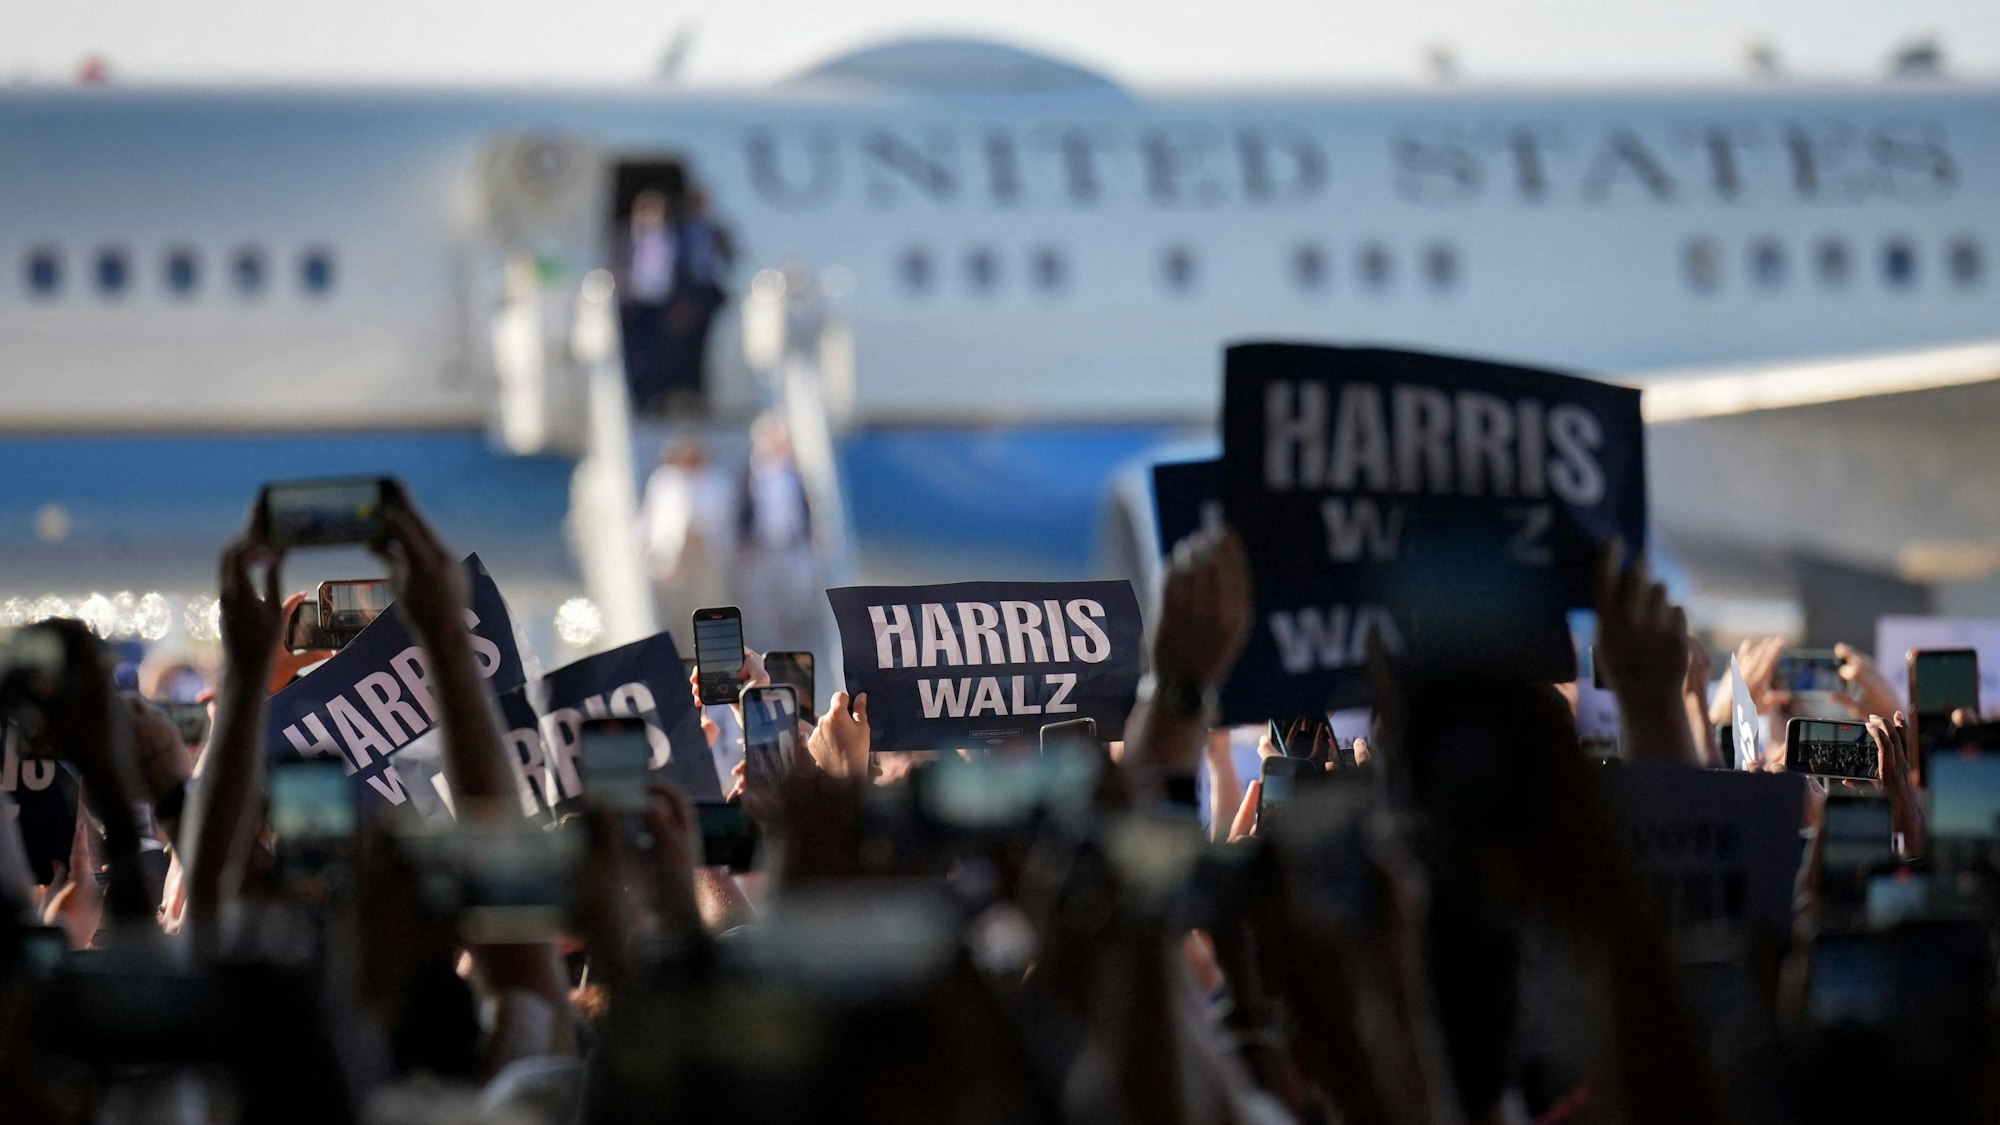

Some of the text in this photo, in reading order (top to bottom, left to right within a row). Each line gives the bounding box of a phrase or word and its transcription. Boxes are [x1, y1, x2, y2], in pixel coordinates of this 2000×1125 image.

[742, 117, 1960, 208] UNITED STATES
[1262, 378, 1607, 507] HARRIS
[1319, 496, 1554, 567] WZ
[867, 598, 1111, 669] HARRIS
[282, 607, 501, 777] HARRS
[917, 672, 1078, 719] WALZ
